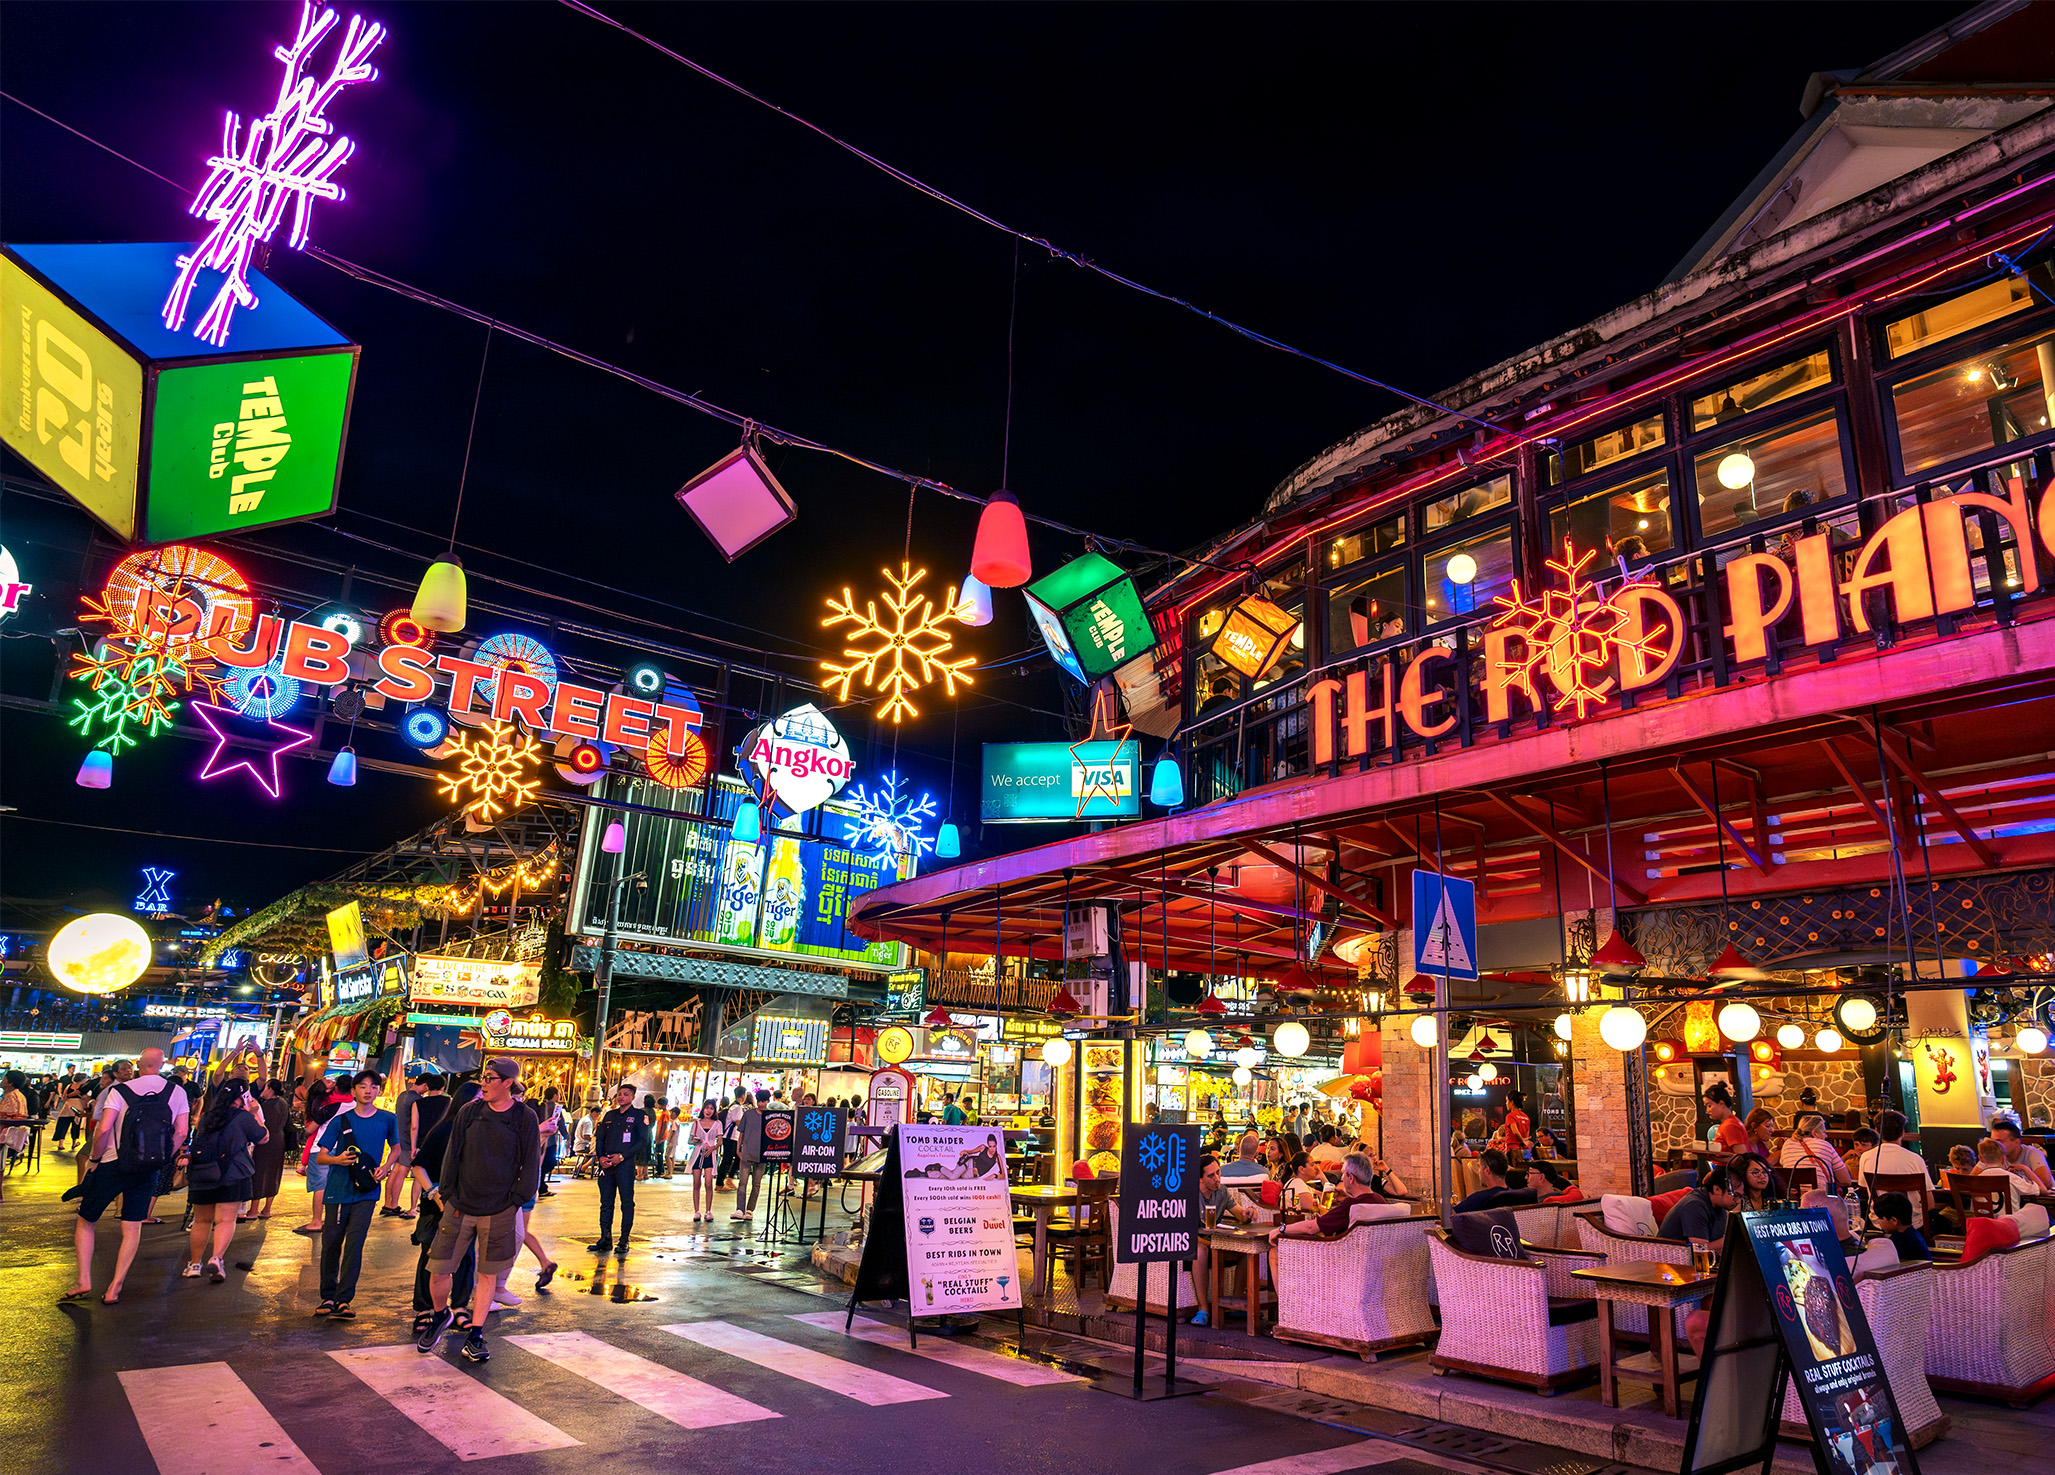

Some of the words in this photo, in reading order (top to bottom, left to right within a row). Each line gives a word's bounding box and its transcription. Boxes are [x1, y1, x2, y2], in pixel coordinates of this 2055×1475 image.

[37, 319, 92, 481] 20
[95, 379, 117, 482] years
[229, 376, 292, 515] TEMPLE
[1305, 648, 1460, 765] THE
[1480, 584, 1685, 723] RED
[1723, 475, 2055, 662] PIAN
[1088, 625, 1104, 649] CLUB
[1089, 599, 1125, 663] TEMPLE
[1224, 630, 1263, 662] TEMPLE
[125, 586, 350, 685] PUB
[374, 644, 703, 756] STREET
[751, 738, 856, 781] Angkor
[991, 773, 1014, 787] We
[1016, 773, 1061, 788] accept
[1083, 769, 1124, 787] VISA
[137, 867, 174, 901] X
[135, 901, 168, 912] BAR
[765, 900, 796, 921] Tiger
[872, 948, 893, 961] Tiger
[436, 961, 459, 970] LIVE
[462, 964, 486, 972] HERE
[146, 1005, 186, 1017] SOUP
[440, 1016, 458, 1024] VEGAS
[506, 1038, 540, 1047] CREAM
[542, 1040, 572, 1049] ROLLS
[878, 1089, 900, 1097] GASOLINE
[906, 1136, 930, 1144] TOMB
[933, 1137, 964, 1145] RAIDER
[801, 1145, 835, 1157] AIR-CON
[797, 1162, 836, 1174] UPSTAIRS
[1137, 1199, 1187, 1219] AIR-CON
[944, 1217, 976, 1225] BELGIAN
[983, 1219, 1006, 1230] Duvel
[1787, 1222, 1803, 1235] RIBS
[1809, 1219, 1829, 1232] TOWN
[949, 1227, 973, 1235] BEERS
[1131, 1232, 1190, 1254] UPSTAIRS
[926, 1251, 945, 1259] BEST
[948, 1250, 967, 1258] RIBS
[979, 1249, 1002, 1257] TOWN
[944, 1286, 988, 1296] COCKTAILS
[1804, 1367, 1823, 1383] REAL
[1821, 1362, 1842, 1379] STUFF
[1842, 1354, 1875, 1373] COCKTAILS
